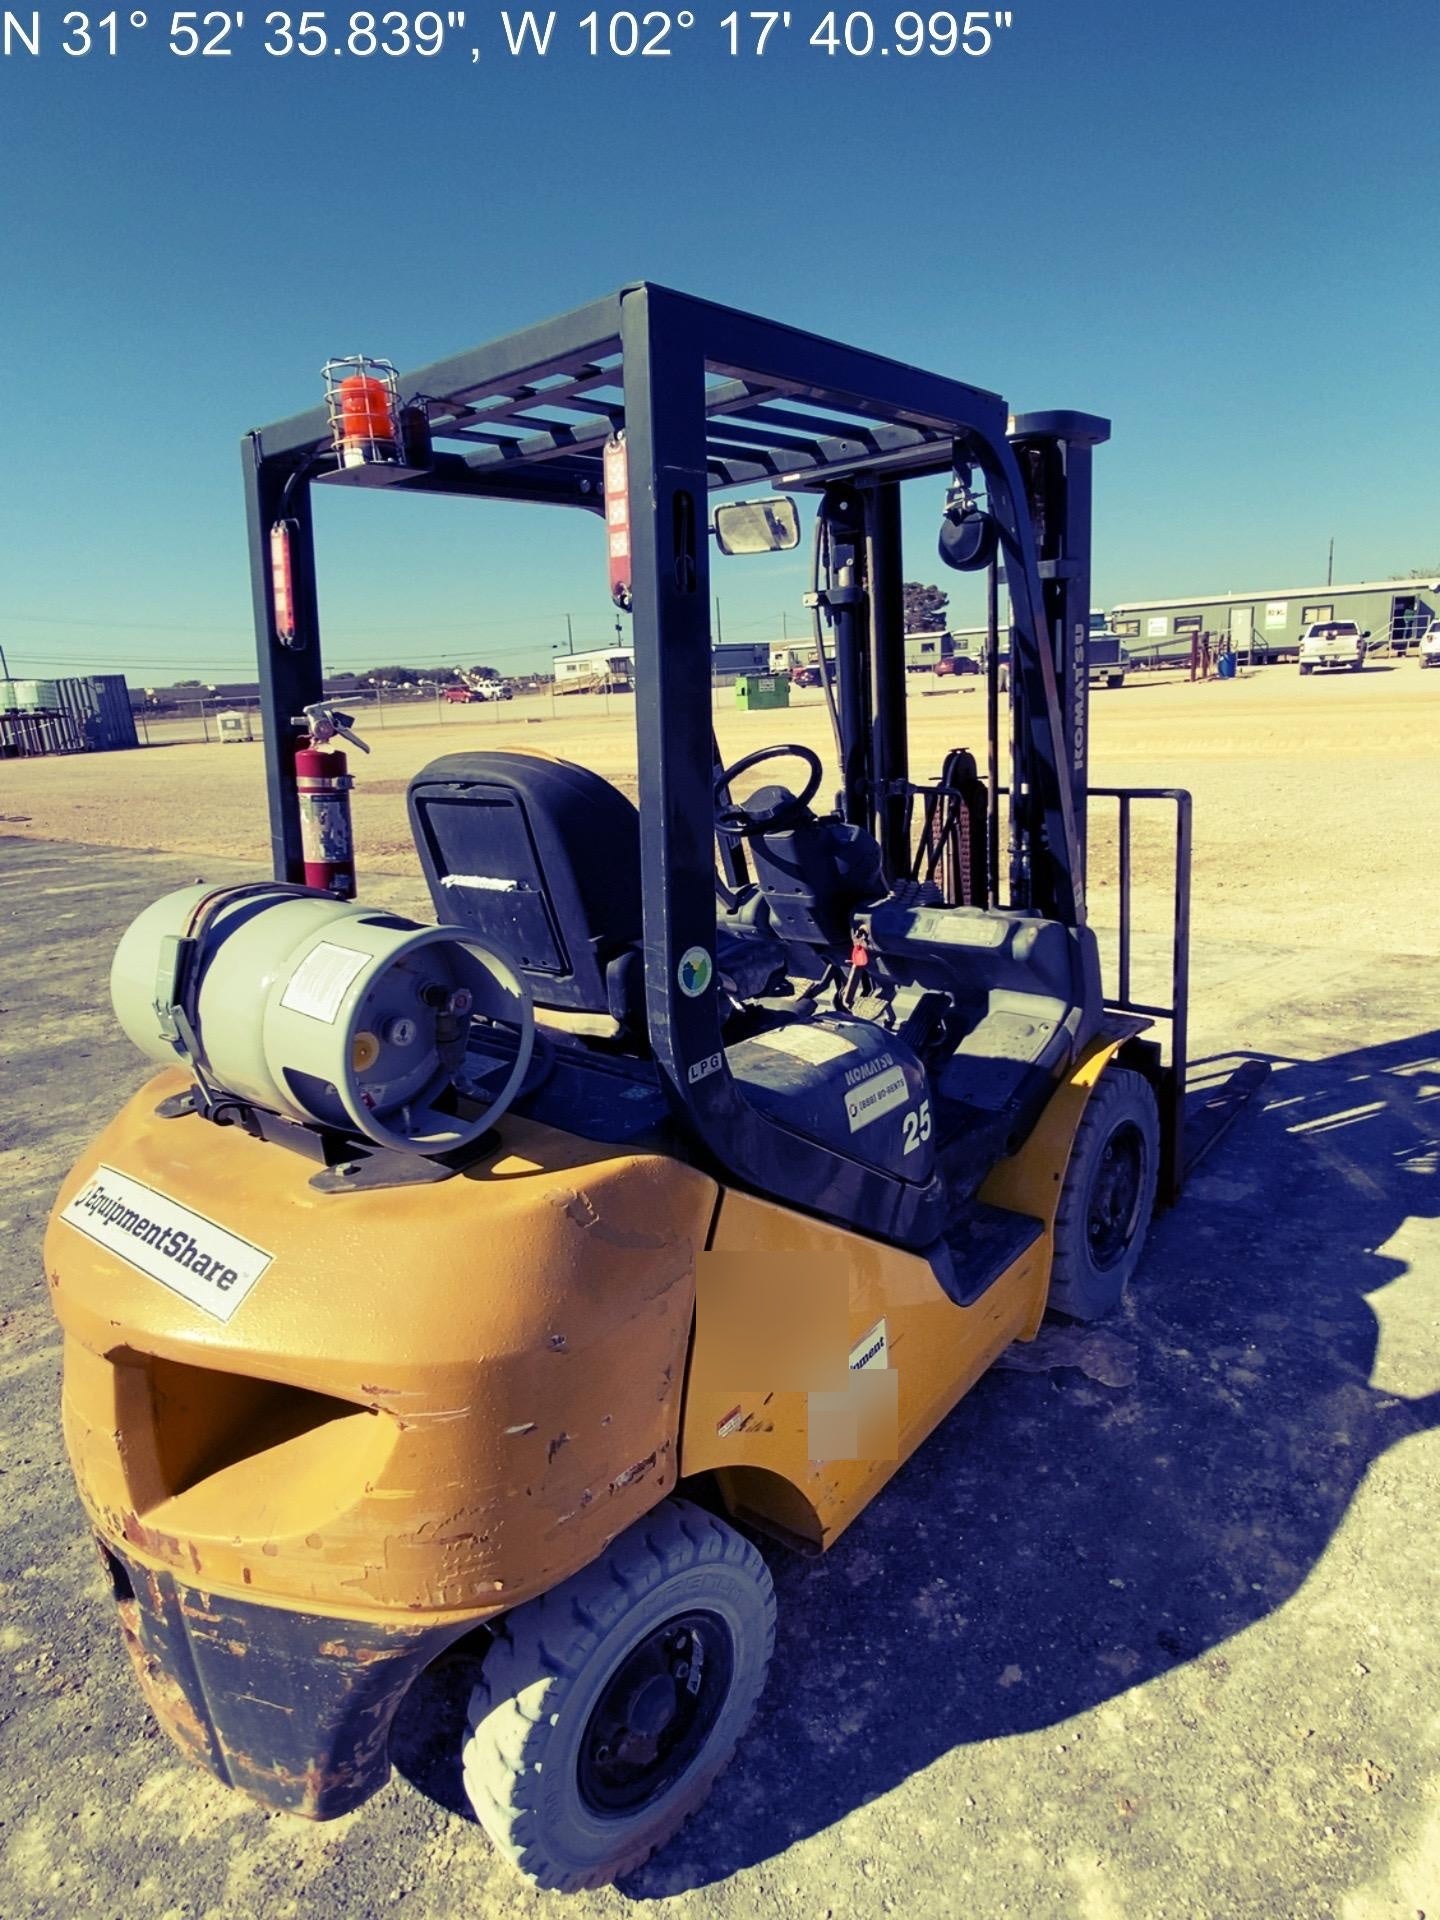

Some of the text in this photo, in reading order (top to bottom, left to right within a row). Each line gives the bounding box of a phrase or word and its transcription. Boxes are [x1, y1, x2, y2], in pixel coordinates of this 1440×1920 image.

[1073, 623, 1085, 770] KOMATSU
[844, 1052, 894, 1086] KOMATSU
[902, 1099, 931, 1155] 25
[84, 1185, 239, 1292] EquipmentShare
